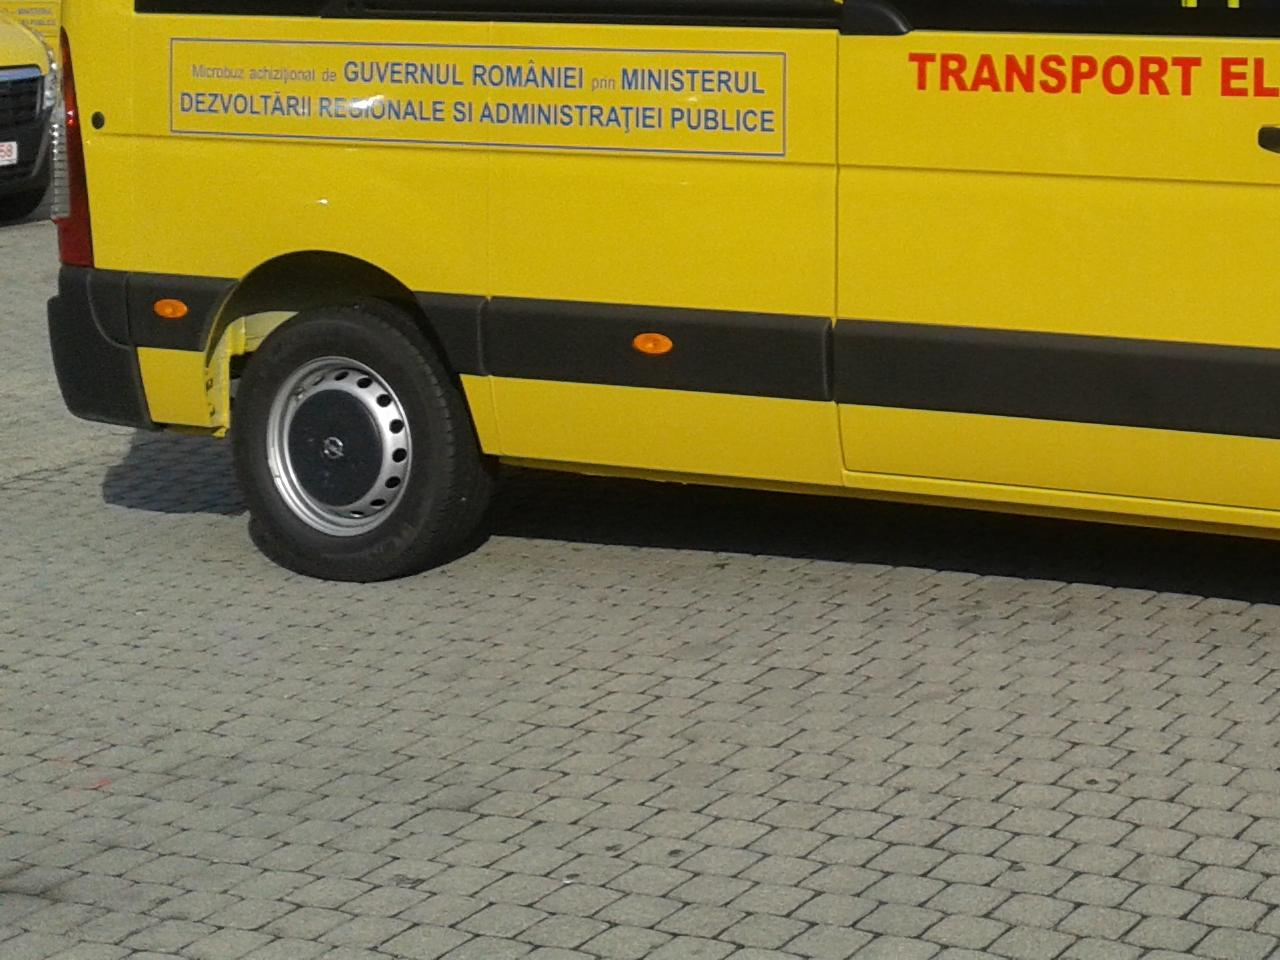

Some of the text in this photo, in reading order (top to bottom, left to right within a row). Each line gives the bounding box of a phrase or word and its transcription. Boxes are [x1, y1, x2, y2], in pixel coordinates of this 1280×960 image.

[192, 64, 243, 80] Microbuz
[322, 67, 337, 82] de
[344, 61, 464, 86] GUVERNUL
[472, 59, 584, 89] ROMÂNIEI
[621, 68, 766, 94] MINISTERUL
[908, 52, 1202, 96] TRANSPORT
[180, 91, 311, 117] DEZVOLTĂRII
[318, 96, 445, 122] REGIONALE
[671, 108, 775, 132] PUBLICE
